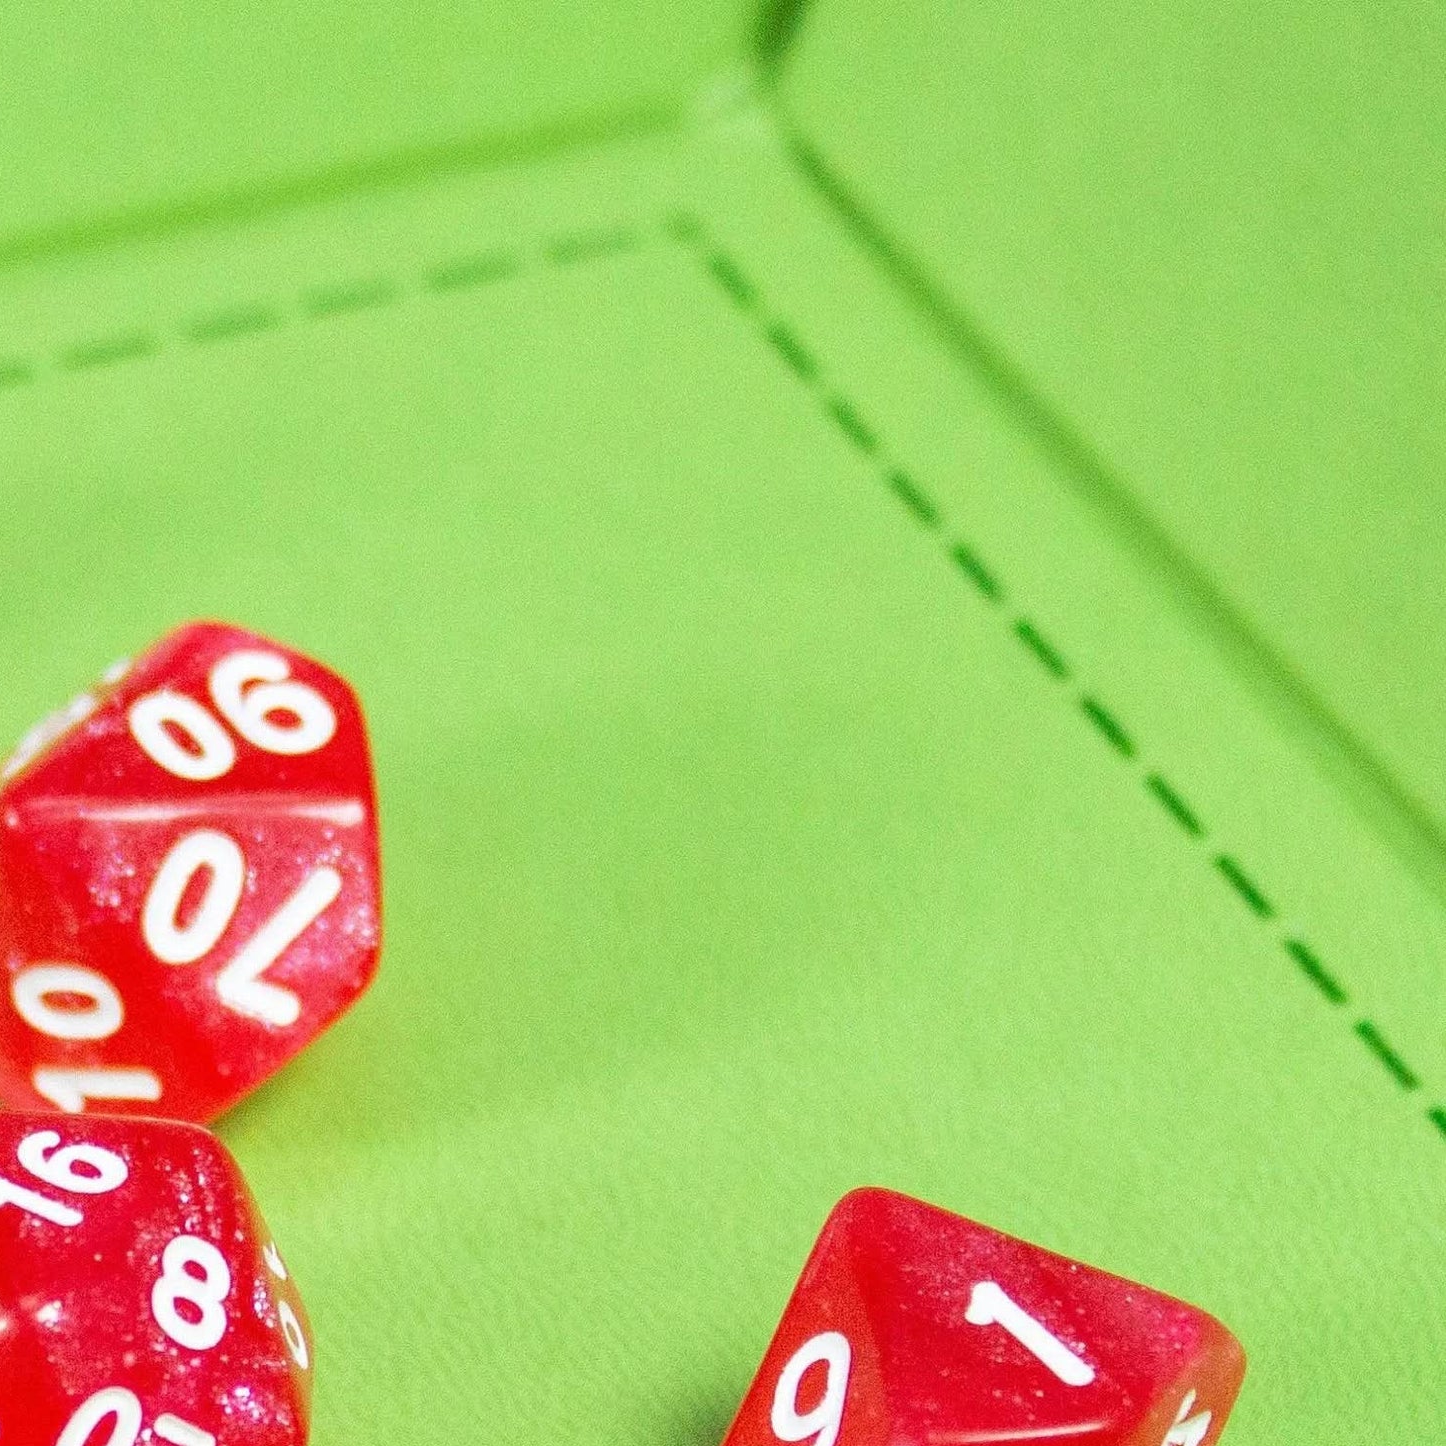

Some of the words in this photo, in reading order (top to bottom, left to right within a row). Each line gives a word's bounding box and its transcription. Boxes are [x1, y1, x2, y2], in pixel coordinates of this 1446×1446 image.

[141, 829, 343, 1028] 70
[10, 962, 164, 1115] 10
[151, 1235, 231, 1351] 8
[965, 1281, 1096, 1387] 1
